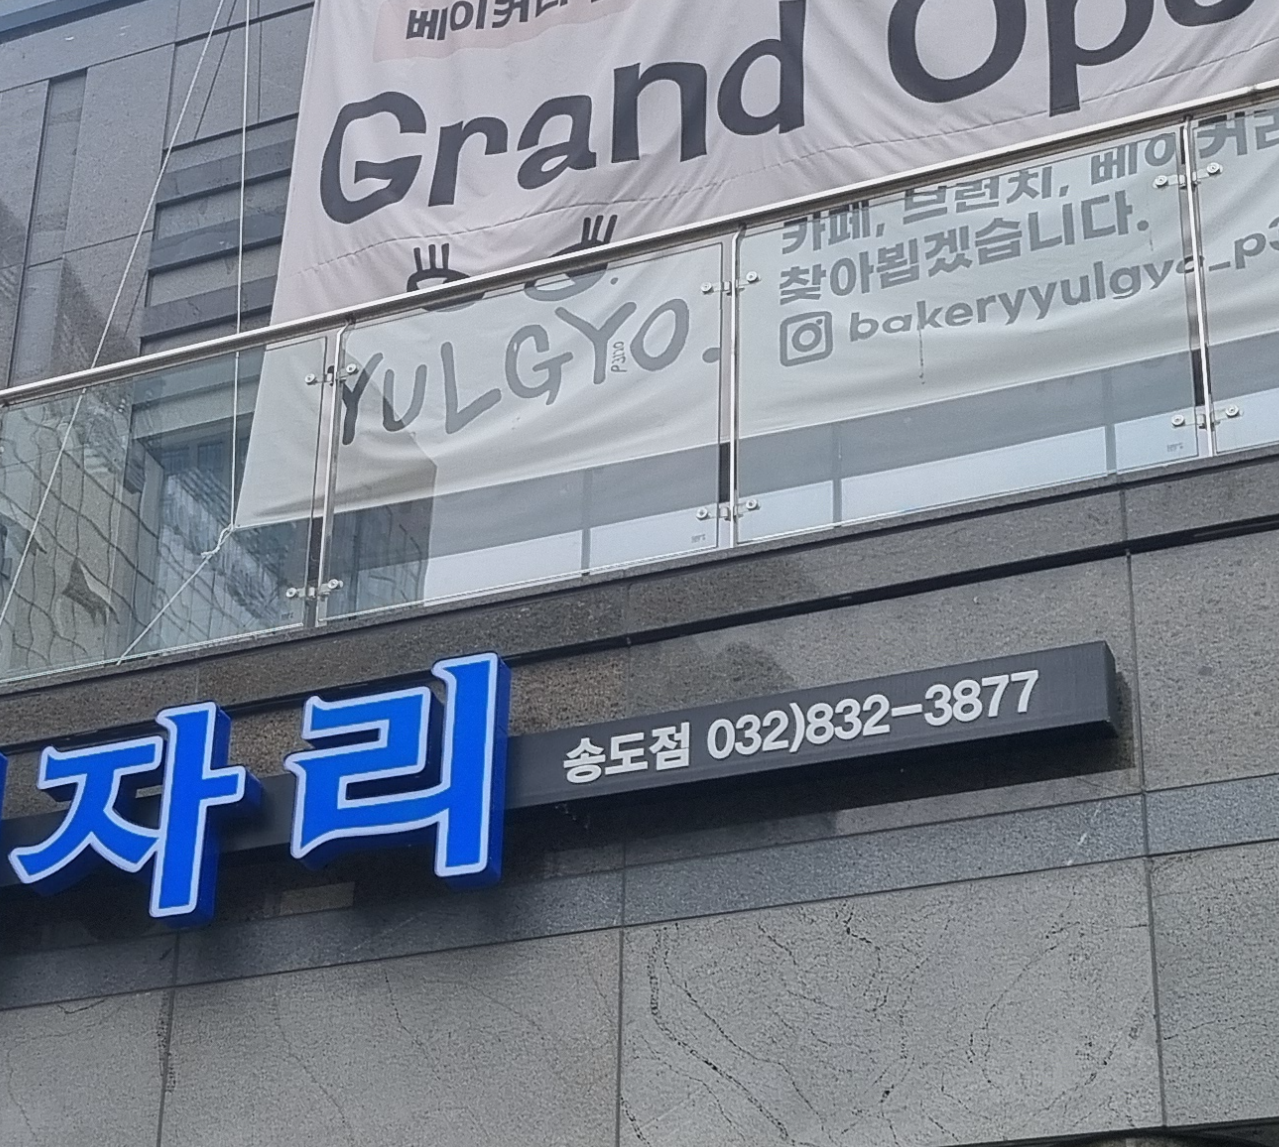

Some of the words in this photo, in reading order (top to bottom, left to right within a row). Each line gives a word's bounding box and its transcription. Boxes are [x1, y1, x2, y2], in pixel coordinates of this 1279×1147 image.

[320, 0, 806, 224] Grand
[888, 0, 1256, 117] Op
[779, 190, 1150, 305] 찾아뵙겠습니다.
[782, 200, 885, 254] 카페,
[562, 722, 691, 784] 송도점
[706, 669, 1040, 759] 032)832-3877
